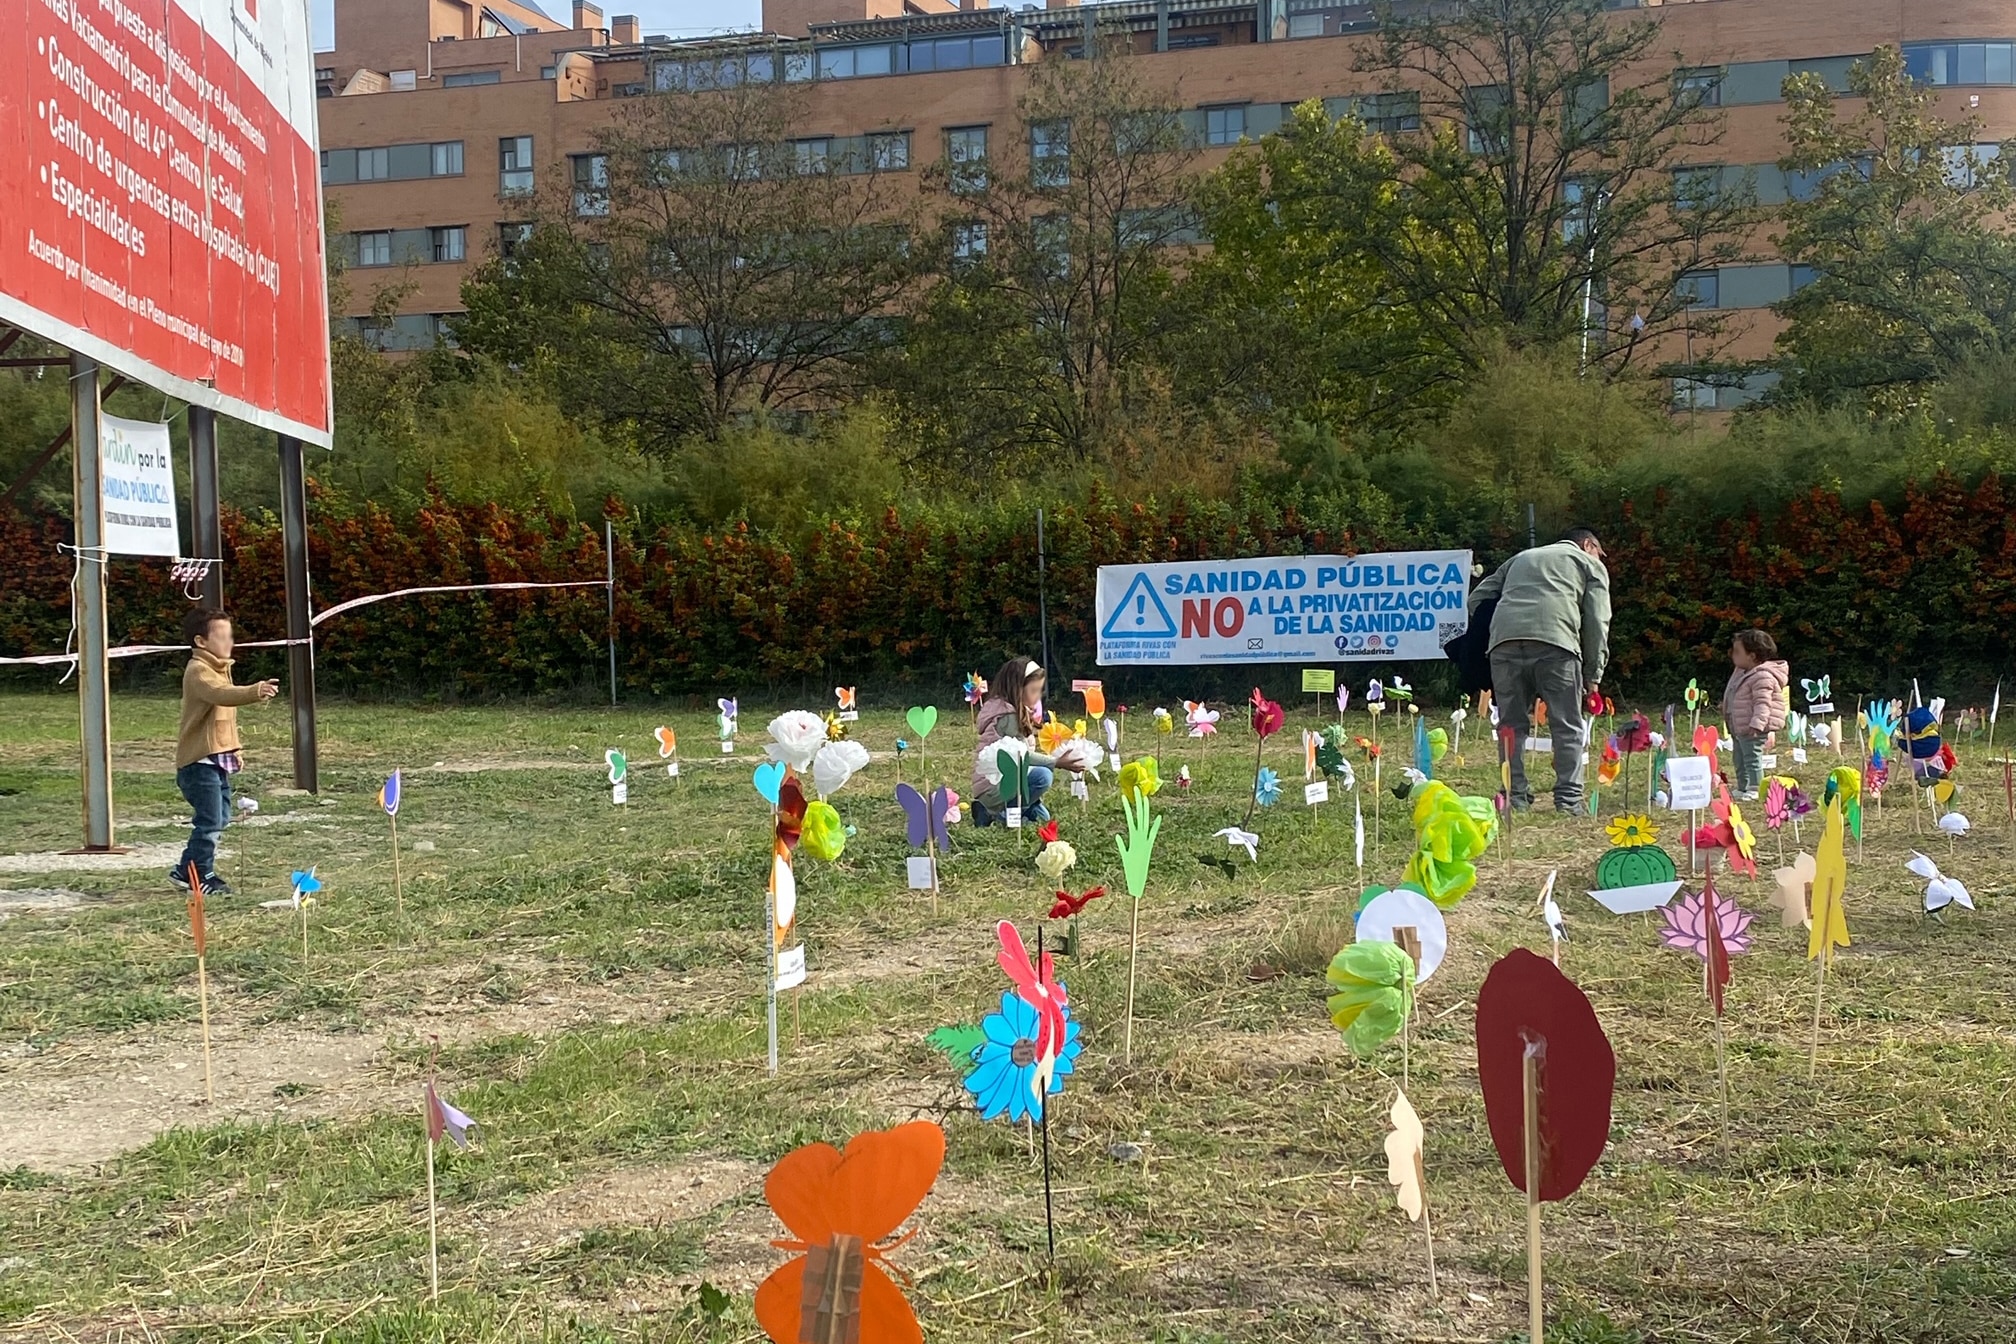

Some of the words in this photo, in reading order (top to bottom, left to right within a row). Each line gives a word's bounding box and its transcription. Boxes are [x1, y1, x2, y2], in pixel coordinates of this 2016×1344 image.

[69, 0, 130, 81] Vaciamadrid
[131, 62, 151, 99] para
[152, 74, 162, 107] la
[147, 27, 154, 51] a
[197, 75, 215, 103] por
[214, 85, 222, 112] el
[49, 35, 130, 137] Construcción
[132, 110, 151, 153] del
[168, 134, 201, 190] Centro
[49, 98, 94, 165] Centro
[96, 137, 112, 178] de
[114, 157, 170, 219] urgencias
[171, 197, 200, 239] extra
[51, 160, 145, 257] Especialidades
[28, 228, 64, 271] Acuerdo
[65, 256, 80, 281] por
[127, 294, 138, 315] en
[139, 295, 146, 319] el
[146, 297, 167, 329] Pleno
[167, 314, 199, 345] municipal
[199, 327, 208, 350] de
[222, 339, 231, 361] de
[138, 453, 153, 472] por
[156, 447, 167, 469] la
[1165, 567, 1307, 595] SANIDAD
[1317, 561, 1464, 589] PÚBLICA
[1181, 596, 1245, 639] NO
[1248, 597, 1263, 616] A
[1268, 596, 1294, 615] LA
[1299, 586, 1463, 614] PRIVATIZACIÓN
[1274, 616, 1301, 635] DE
[1307, 615, 1335, 634] LA
[1339, 611, 1436, 633] SANIDAD
[1104, 651, 1112, 660] LA
[1338, 647, 1395, 656] @sanidadrivas
